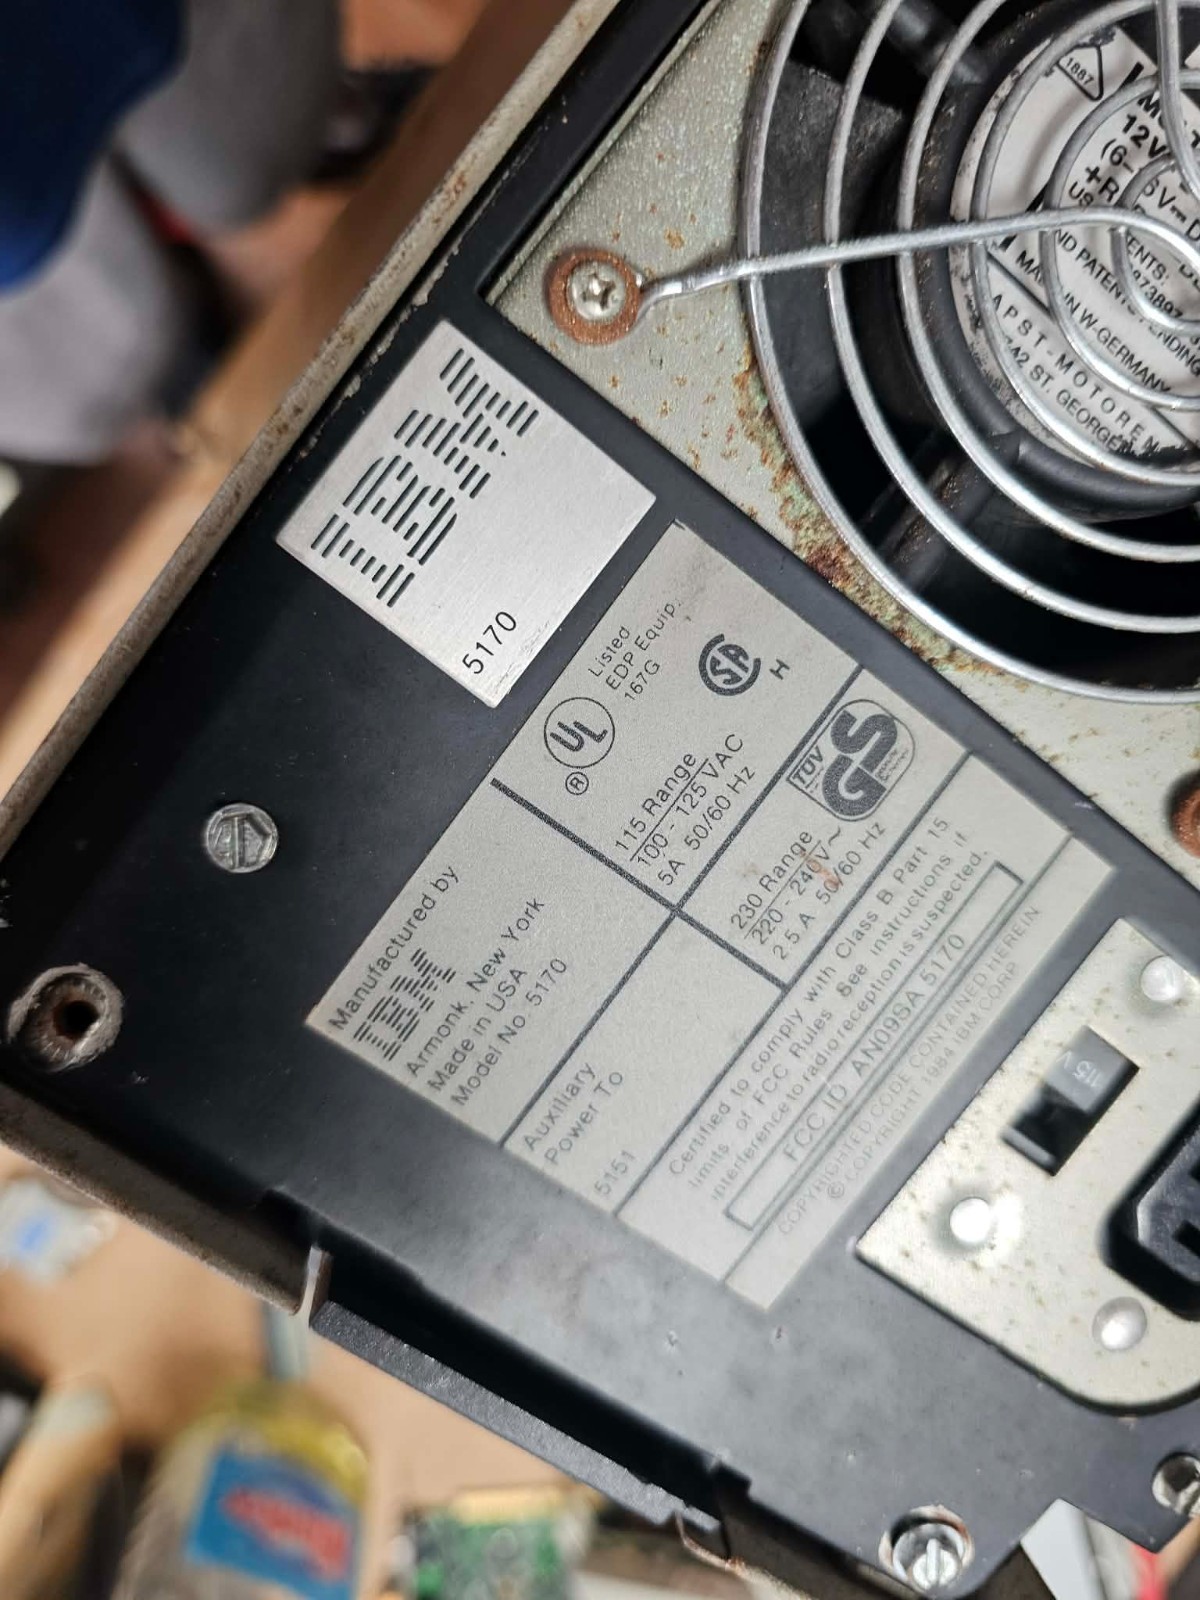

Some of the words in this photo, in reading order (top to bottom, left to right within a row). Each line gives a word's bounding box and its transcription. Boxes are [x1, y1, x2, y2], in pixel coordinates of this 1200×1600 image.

[1065, 56, 1095, 87] 1887
[310, 346, 540, 609] IBM
[460, 608, 519, 675] 5170
[588, 625, 632, 678] Listed
[604, 650, 640, 690] EDP
[623, 658, 662, 702] 167G
[769, 658, 791, 680] H
[614, 816, 648, 853] 115
[641, 750, 700, 817] Range
[636, 831, 670, 869] 100
[675, 781, 709, 817] 125
[702, 732, 745, 781] VAC
[656, 855, 686, 886] 5A
[683, 792, 733, 852] 50/60
[725, 763, 756, 794] Hz
[729, 891, 764, 930] 230
[758, 828, 814, 892] Range
[749, 906, 785, 945] 220
[795, 909, 816, 929] A
[813, 847, 863, 904] 50/60
[856, 819, 887, 849] Hz
[328, 892, 437, 1032] Manufactured
[429, 863, 462, 893] by
[466, 944, 508, 992] New
[500, 894, 546, 945] York
[666, 1100, 732, 1177] Certified
[728, 1076, 750, 1096] to
[749, 1005, 806, 1074] comply
[802, 963, 837, 1003] with
[832, 908, 880, 961] Class
[875, 887, 895, 905] B
[891, 843, 929, 883] Part
[925, 816, 950, 839] 15
[352, 946, 457, 1062] IBM
[426, 1034, 476, 1092] Made
[468, 1012, 492, 1035] in
[484, 963, 528, 1013] USA
[450, 1043, 503, 1107] Model
[523, 956, 568, 1007] 5170
[687, 1140, 731, 1189] limits
[732, 1109, 754, 1132] of
[751, 1061, 790, 1105] FCC
[788, 1006, 833, 1058] Rules
[835, 960, 869, 998] See
[868, 852, 953, 956] instructions
[951, 830, 969, 847] if
[709, 1099, 791, 1202] interference
[784, 1081, 805, 1100] to
[799, 1035, 841, 1082] radio
[836, 955, 903, 1037] reception
[896, 939, 916, 957] is
[908, 842, 989, 942] suspected.
[781, 1110, 827, 1162] FCC
[821, 1081, 850, 1111] ID
[918, 931, 967, 987] 5170
[520, 1060, 597, 1151] Auxiliary
[542, 1101, 600, 1166] Power
[593, 1066, 625, 1100] To
[776, 1117, 873, 1237] COPYRIGHTED
[867, 1068, 911, 1120] CODE
[906, 969, 990, 1070] CONTAINED
[981, 903, 1042, 972] HEREIN
[844, 1084, 924, 1182] COPYRIGHT
[950, 1011, 981, 1045] IBM
[592, 1148, 636, 1197] 5151
